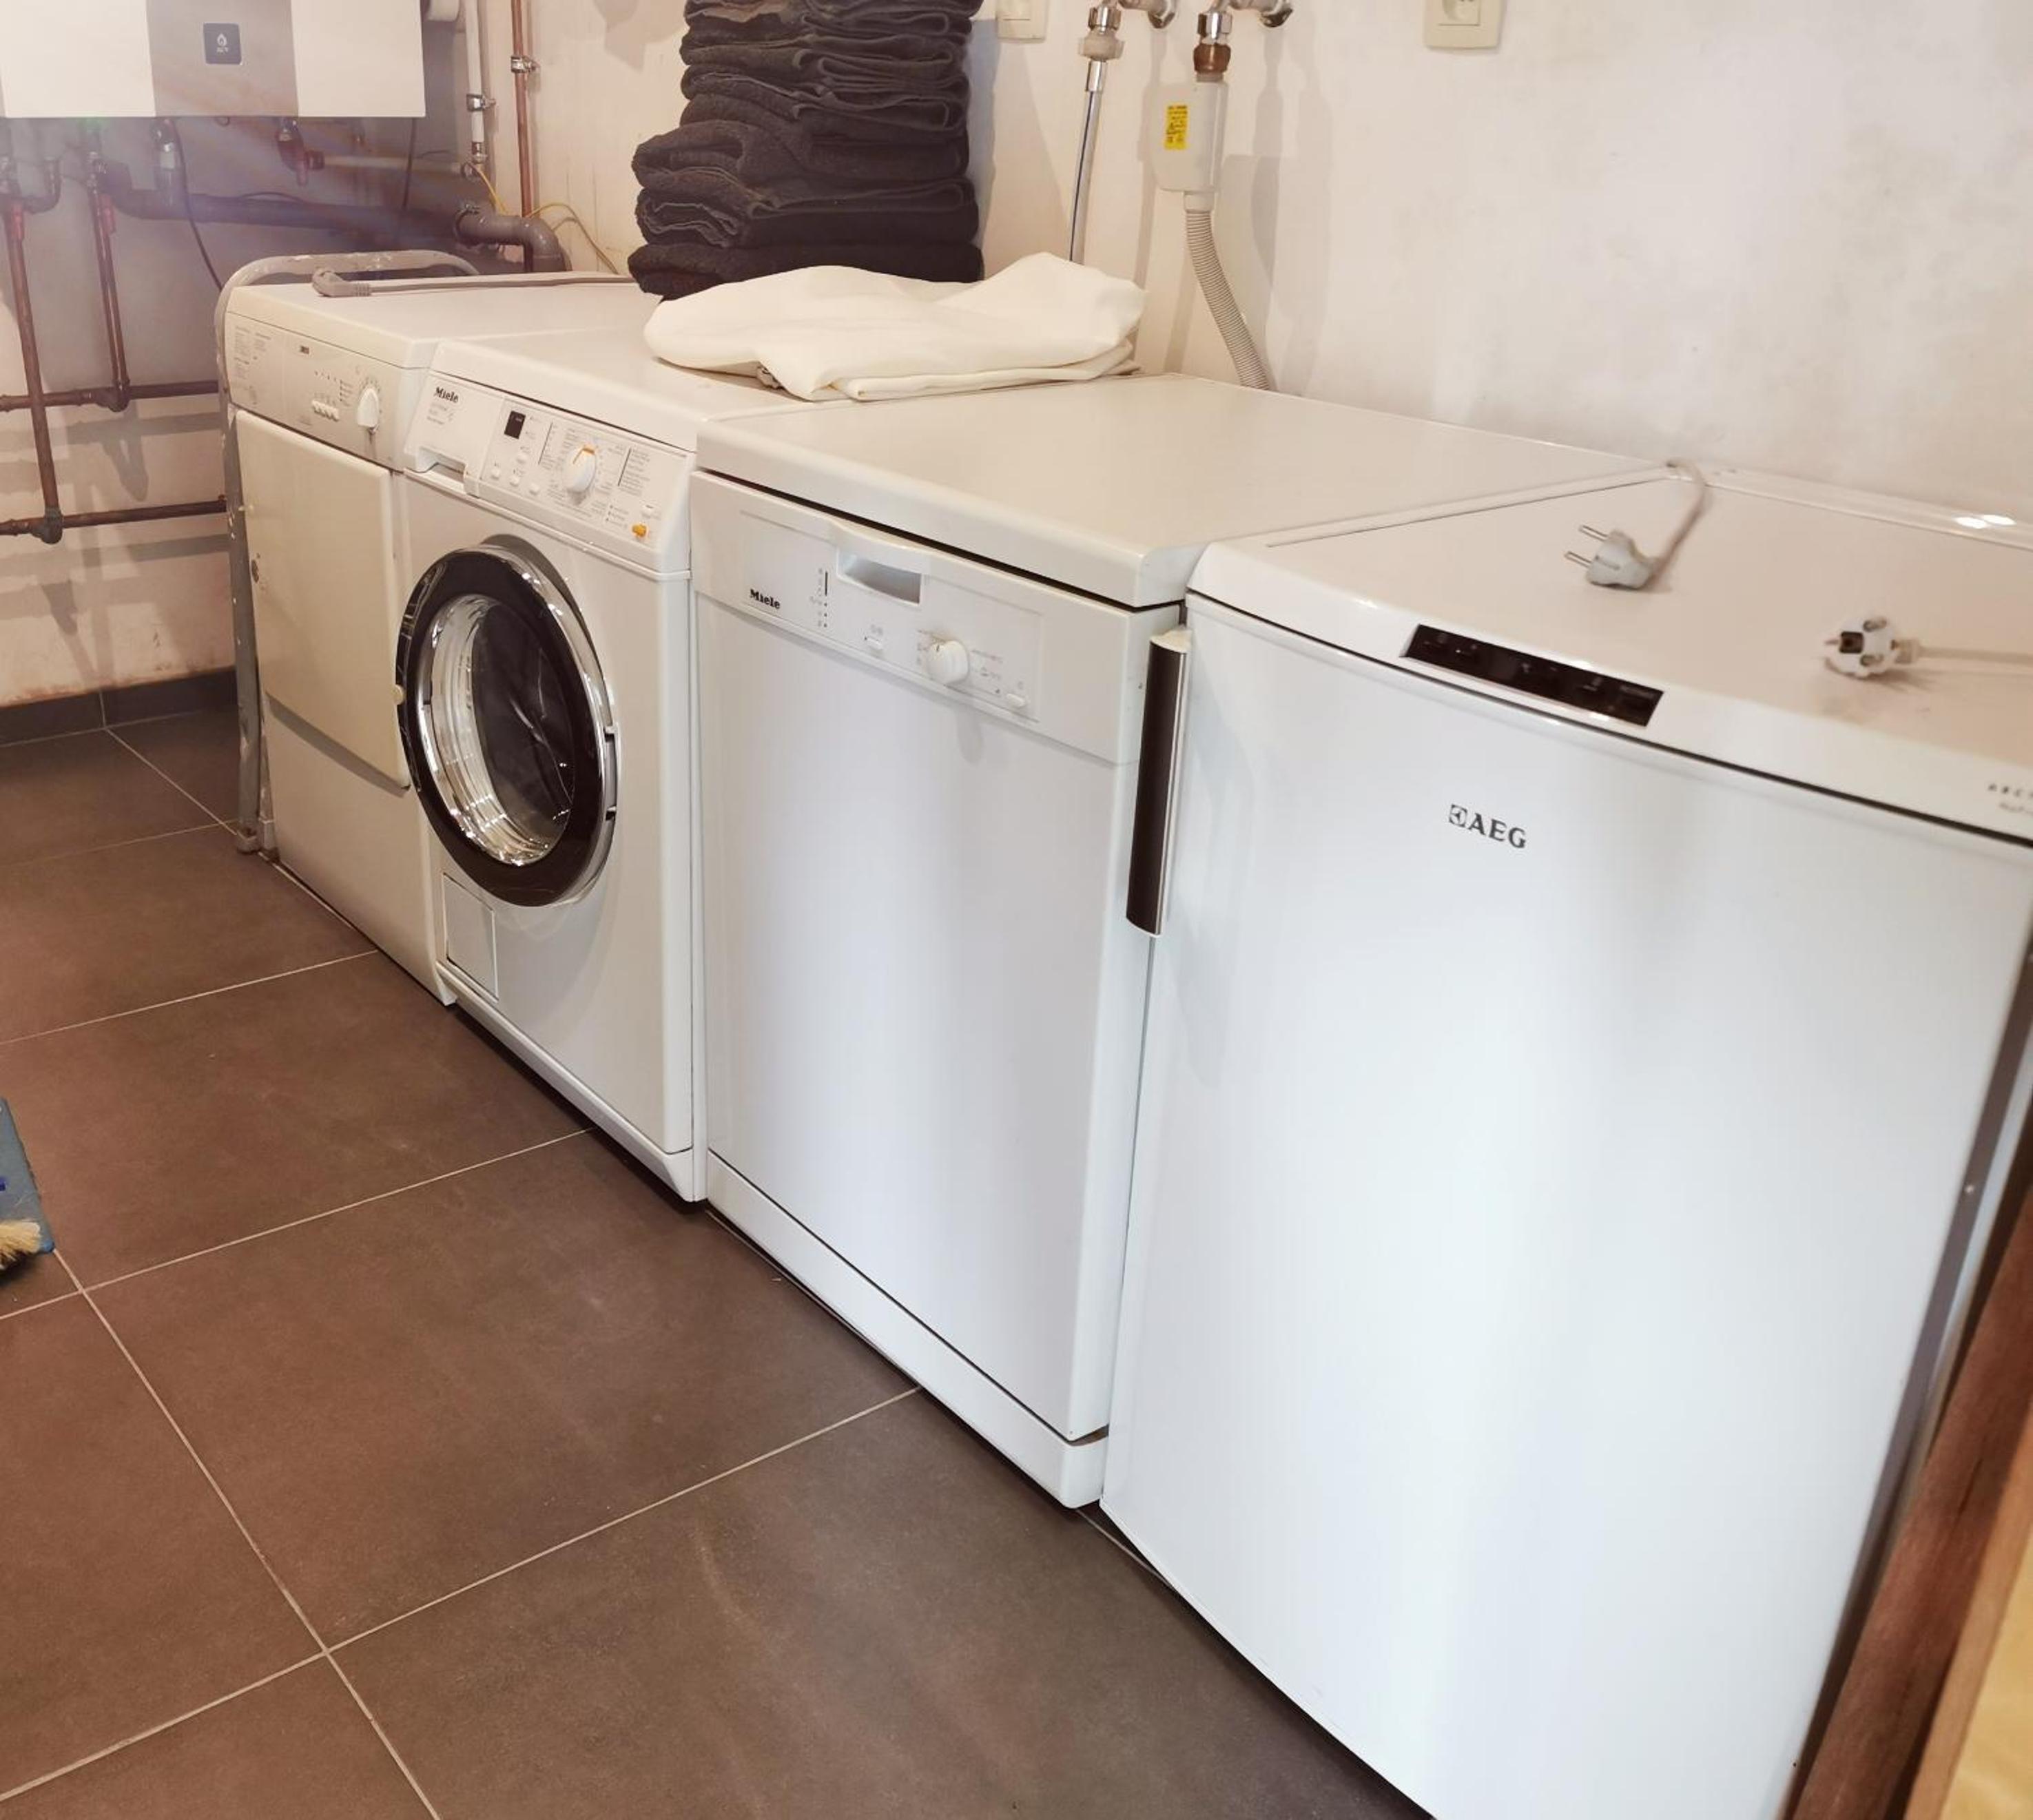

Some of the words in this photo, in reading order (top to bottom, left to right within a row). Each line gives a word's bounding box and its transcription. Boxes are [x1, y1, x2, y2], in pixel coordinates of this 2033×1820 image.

[434, 386, 459, 403] Miele
[750, 588, 781, 610] Miele
[1467, 812, 1527, 849] AEG
